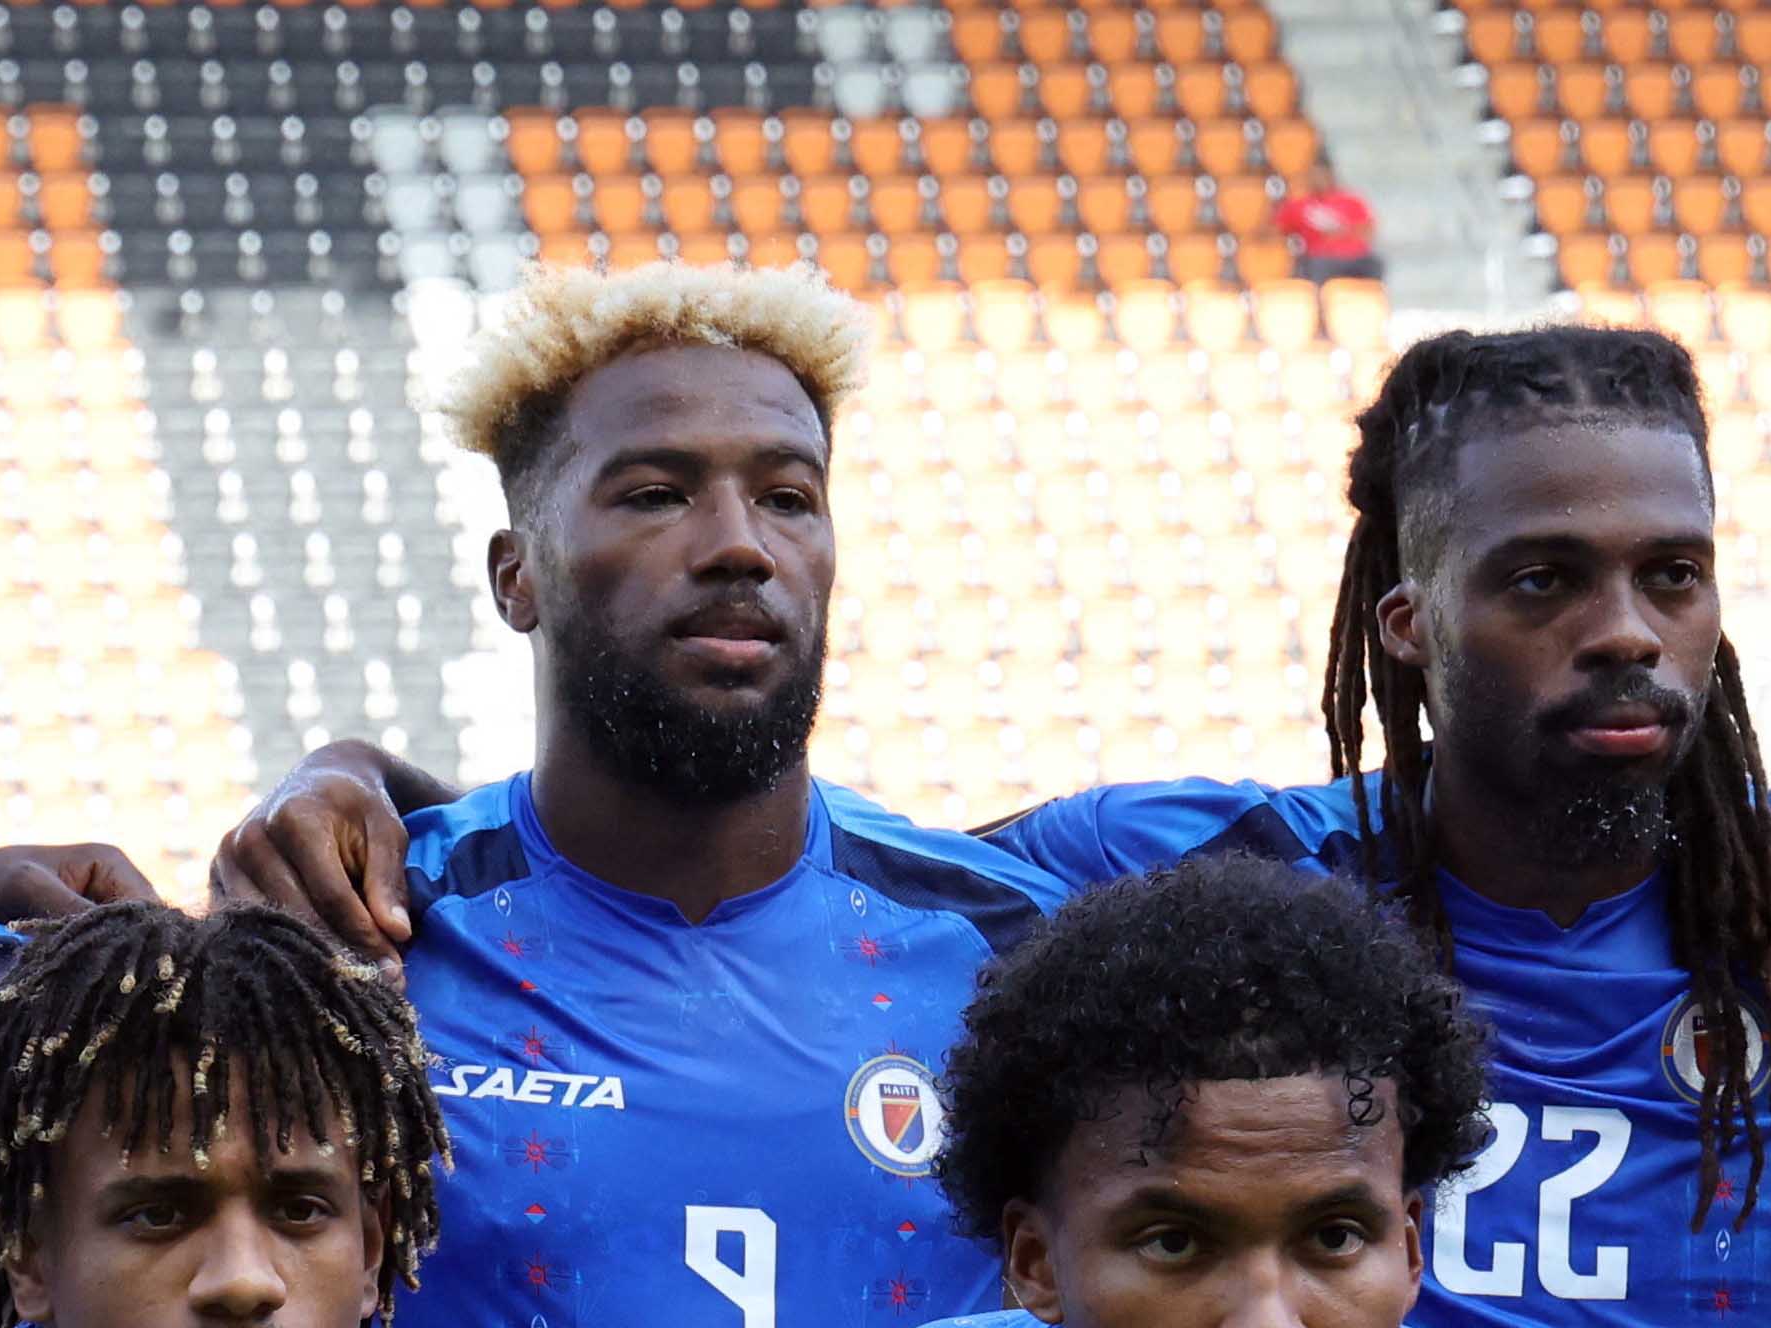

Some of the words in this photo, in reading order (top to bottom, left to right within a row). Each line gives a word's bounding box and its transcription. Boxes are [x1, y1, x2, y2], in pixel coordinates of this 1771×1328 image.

[434, 1064, 625, 1110] SAETA
[883, 1085, 916, 1096] HAITI
[1431, 1102, 1633, 1300] 22
